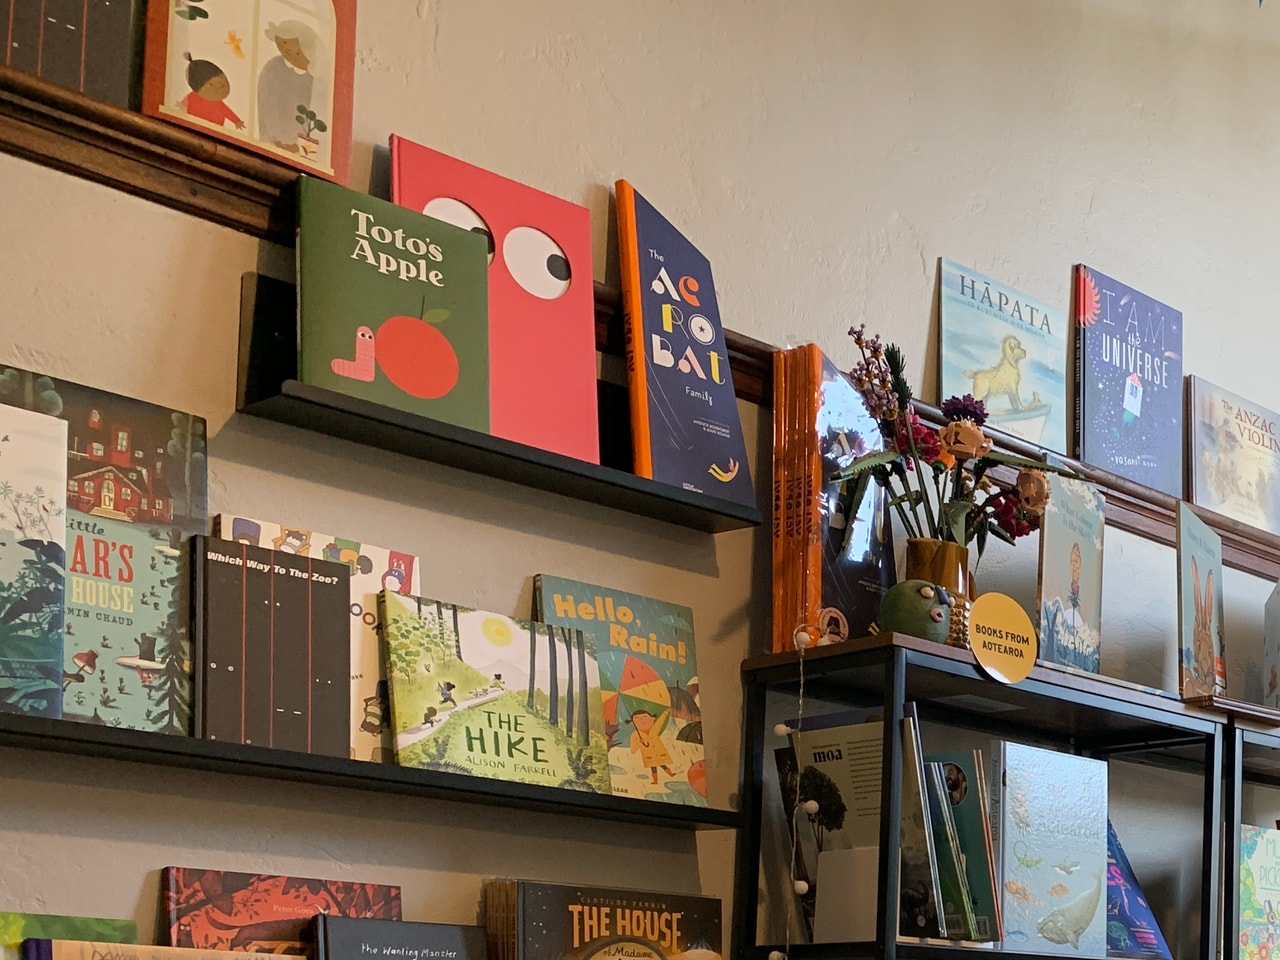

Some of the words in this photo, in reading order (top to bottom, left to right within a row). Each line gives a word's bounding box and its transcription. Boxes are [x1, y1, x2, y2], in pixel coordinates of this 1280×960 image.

[351, 208, 444, 263] Toto's
[350, 236, 445, 287] Apple
[649, 249, 664, 263] The
[650, 266, 701, 307] AC
[959, 274, 1053, 336] HĀPATA
[1103, 288, 1115, 326] I
[1125, 301, 1165, 351] AM
[661, 303, 716, 346] RO
[1127, 332, 1142, 348] the
[1102, 333, 1168, 389] UNIVERSE
[685, 386, 713, 407] Family
[1222, 399, 1233, 412] The
[1235, 406, 1276, 435] ANZAC
[207, 551, 243, 567] Which
[246, 559, 271, 573] Way
[272, 565, 286, 575] To
[288, 568, 309, 580] The
[311, 572, 339, 586] Zoo?
[71, 575, 134, 614] HOUSE
[553, 594, 641, 627] Hello,
[96, 612, 133, 626] CHAUD
[975, 624, 1004, 639] BOOKS
[1005, 630, 1030, 646] FROM
[610, 624, 687, 665] Rain!
[982, 640, 1025, 658] AOTEAROA
[483, 710, 526, 733] THE
[465, 726, 549, 763] HIKE
[813, 748, 843, 763] moa
[465, 755, 505, 769] ALISON
[513, 763, 557, 778] FARRELL
[568, 904, 611, 948] THE
[616, 908, 682, 953] HOUSE
[614, 947, 655, 959] Madame
